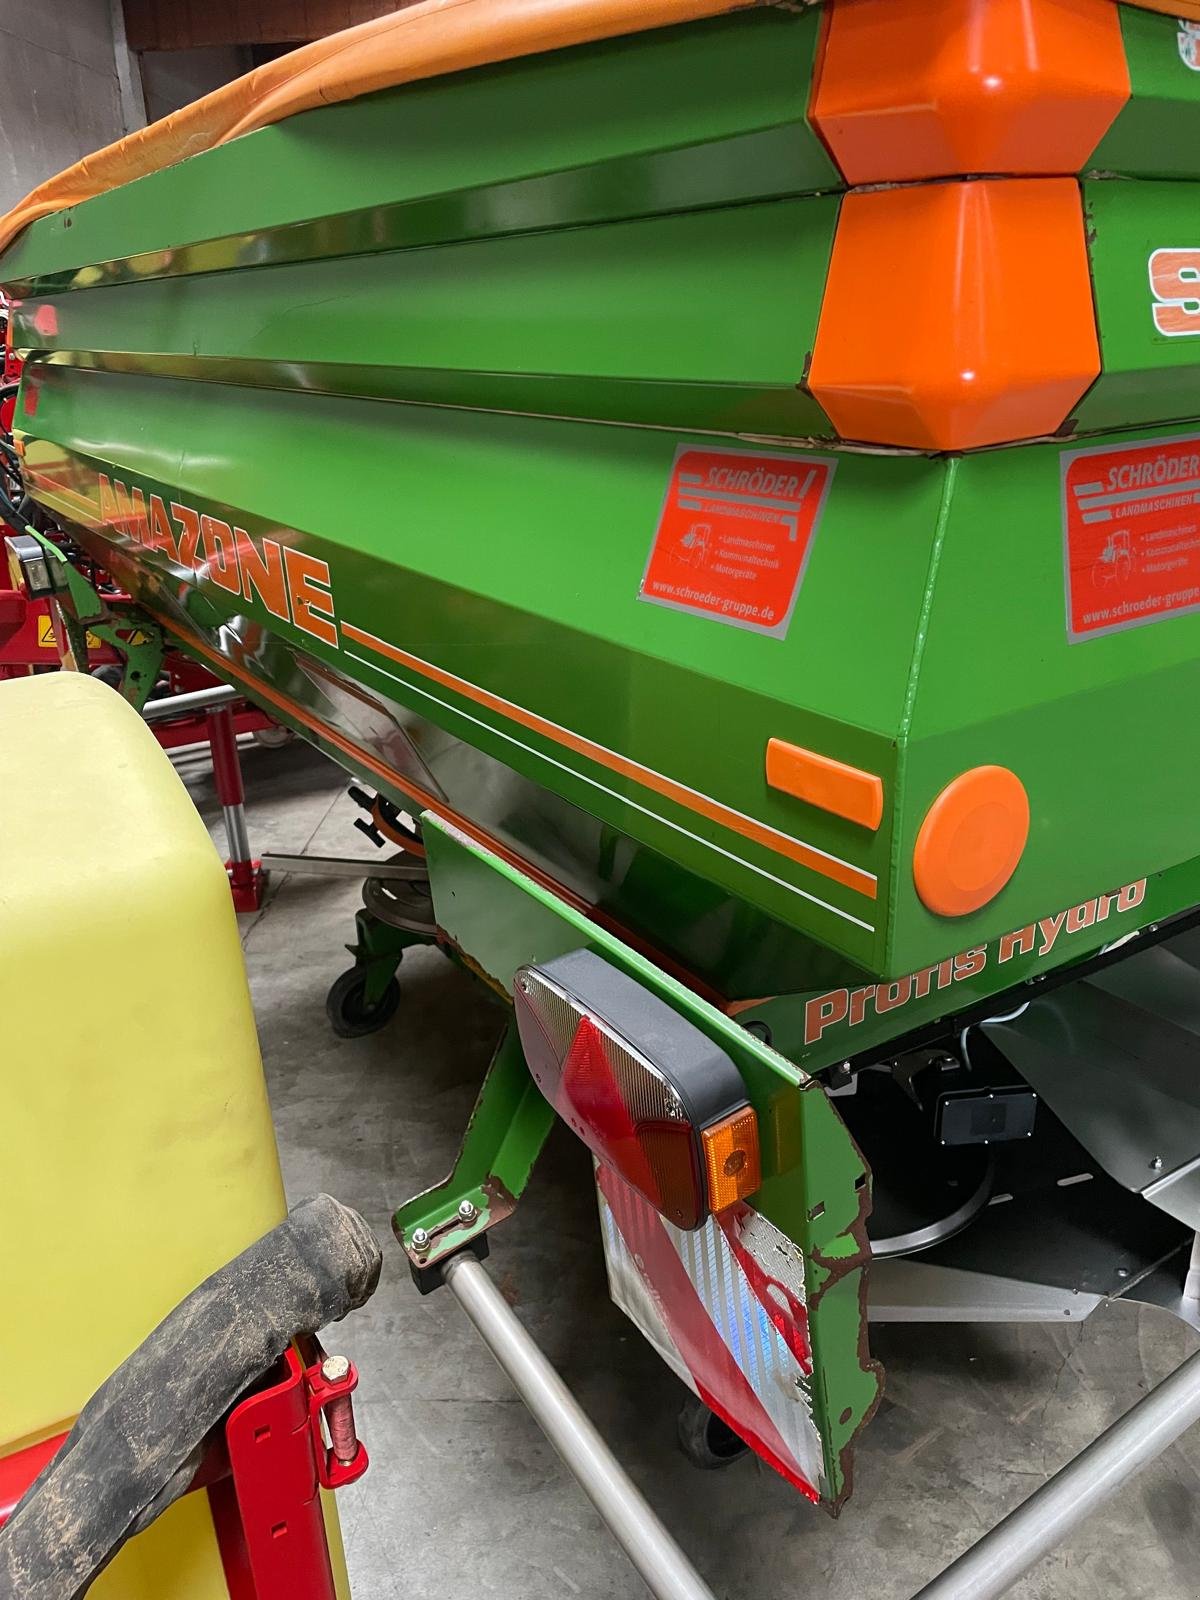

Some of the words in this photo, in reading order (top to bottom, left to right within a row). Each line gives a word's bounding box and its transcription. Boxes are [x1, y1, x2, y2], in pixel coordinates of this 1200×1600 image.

[705, 466, 798, 497] SCHRÖDER
[1106, 454, 1200, 491] SCHRÖDER
[99, 472, 339, 649] AMAZONE
[652, 580, 775, 620] www.schroeder-gruppe.de
[998, 877, 1148, 964] Hydro
